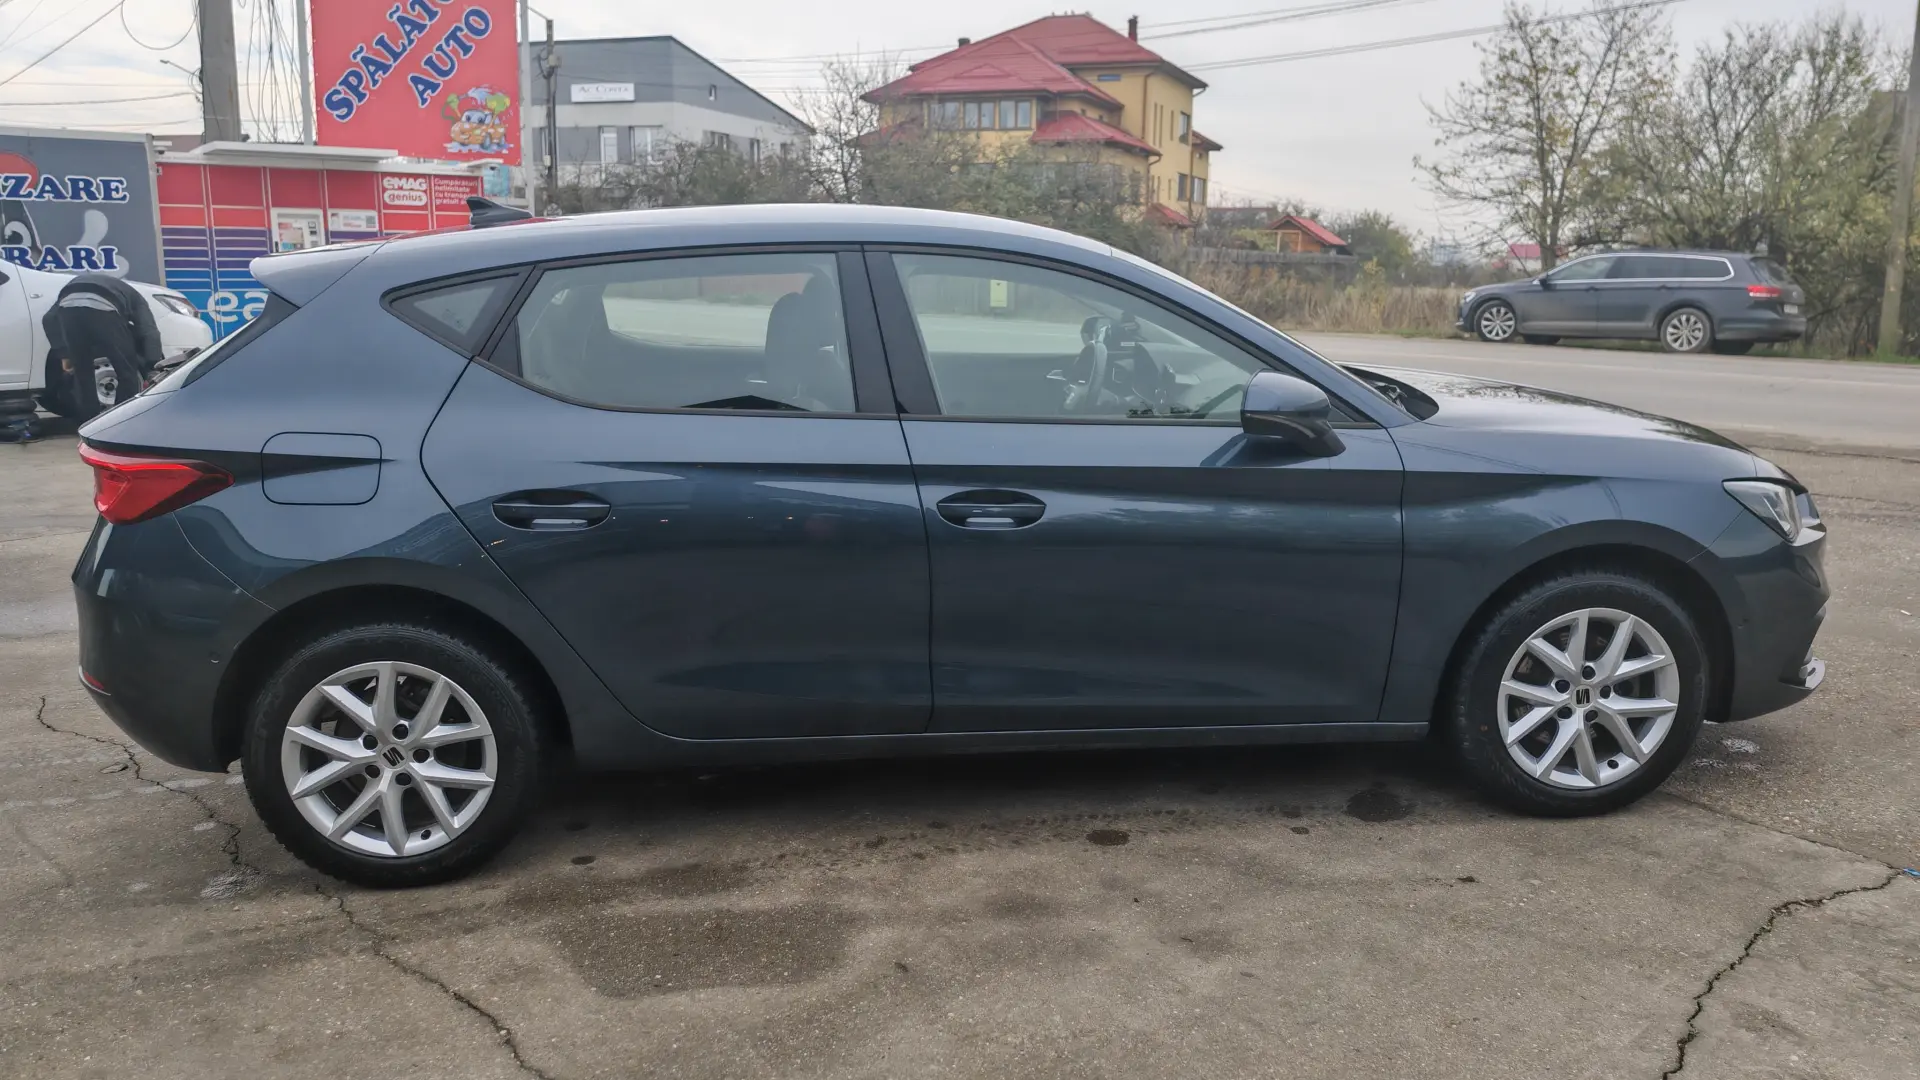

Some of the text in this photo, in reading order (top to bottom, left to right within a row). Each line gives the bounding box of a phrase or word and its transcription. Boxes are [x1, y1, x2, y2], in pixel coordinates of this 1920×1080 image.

[408, 6, 492, 108] AUTO
[0, 173, 129, 203] ZARE
[388, 192, 423, 203] genius
